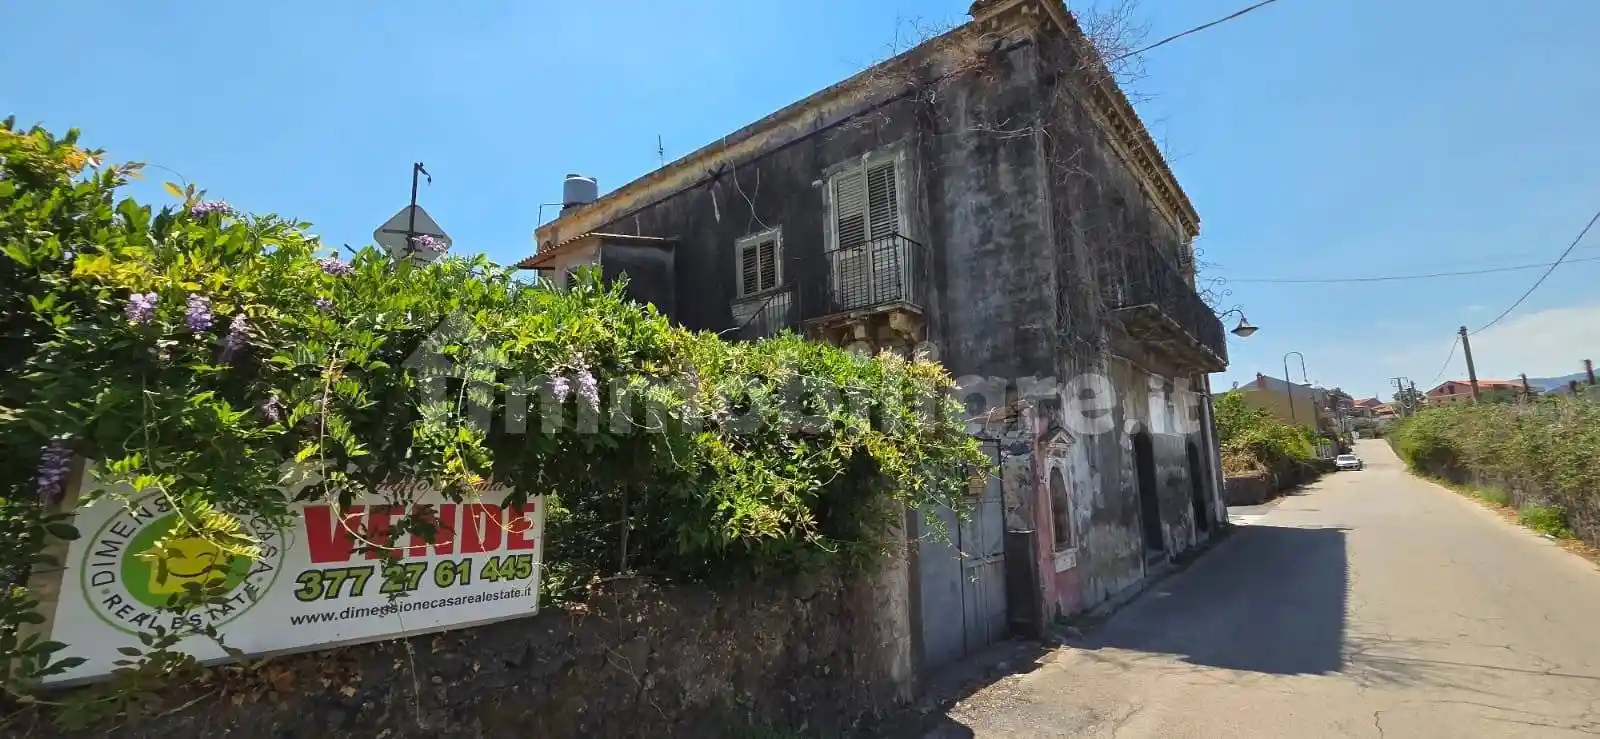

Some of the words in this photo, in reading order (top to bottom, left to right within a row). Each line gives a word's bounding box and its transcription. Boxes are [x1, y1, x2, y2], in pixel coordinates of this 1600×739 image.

[303, 503, 535, 563] VENDE
[293, 566, 374, 602] 377
[380, 562, 428, 593] 27
[434, 558, 472, 588] 61
[480, 554, 533, 582] 445
[102, 593, 161, 631] REAL
